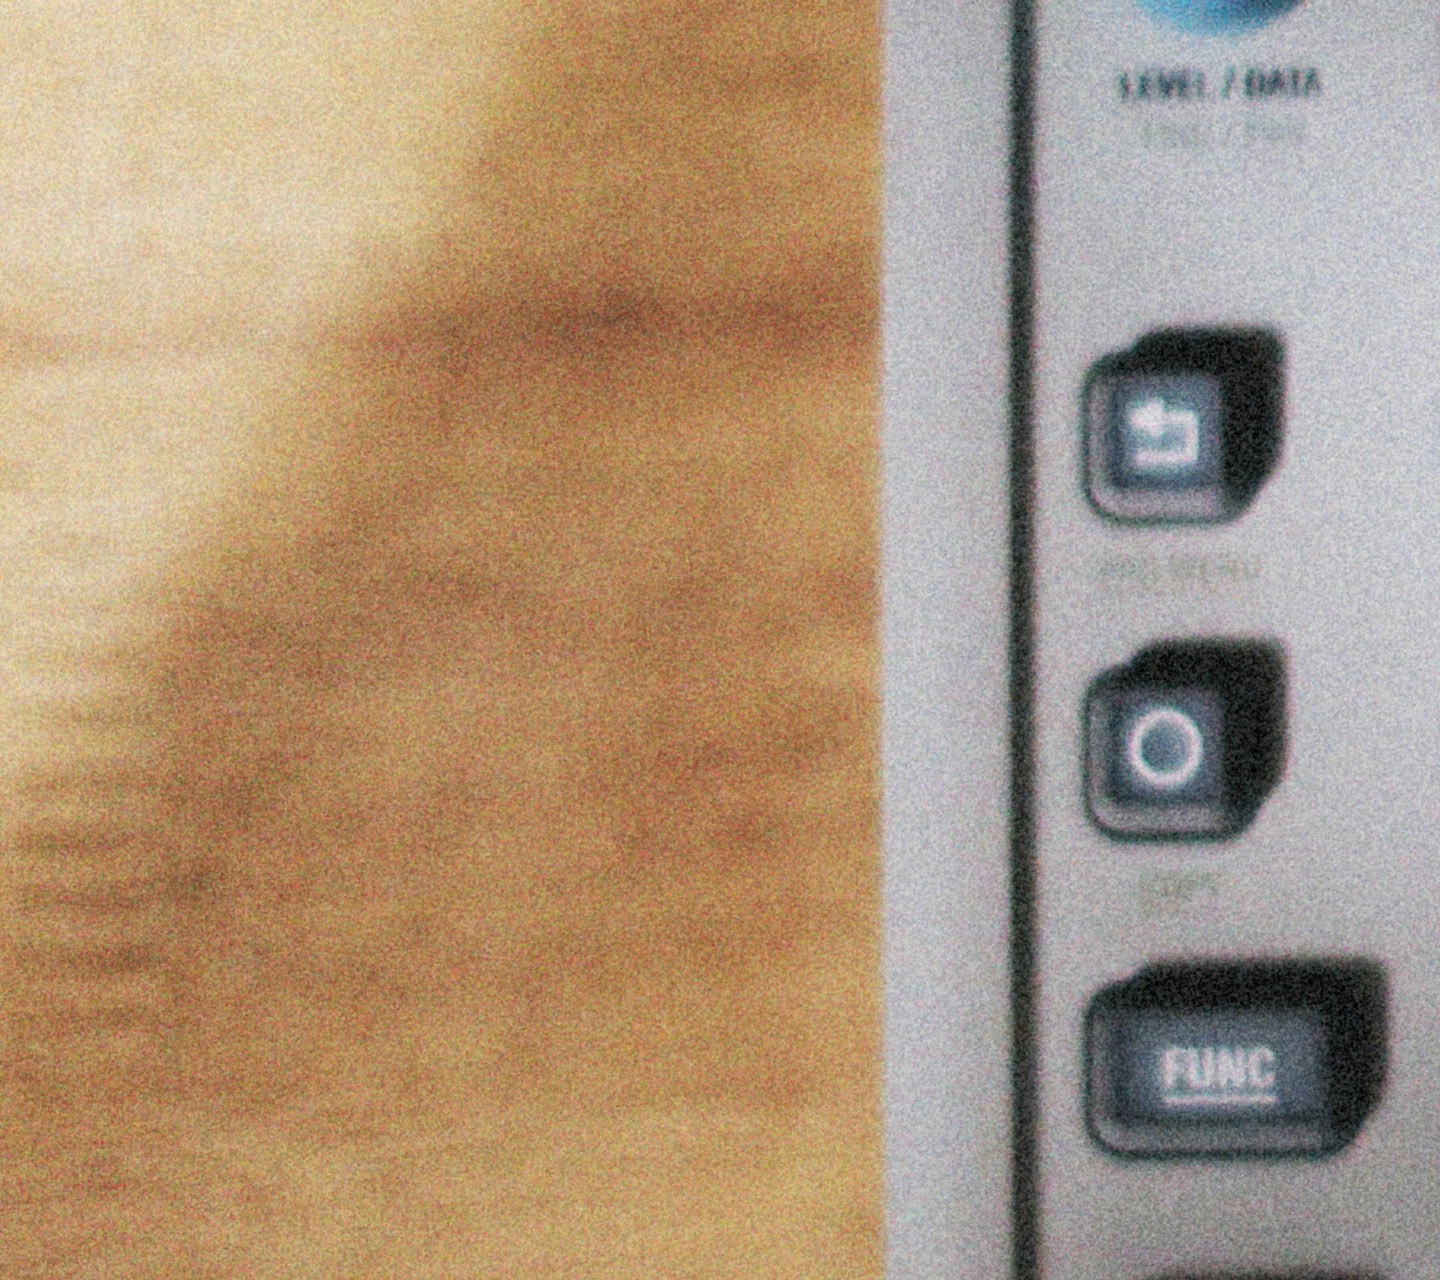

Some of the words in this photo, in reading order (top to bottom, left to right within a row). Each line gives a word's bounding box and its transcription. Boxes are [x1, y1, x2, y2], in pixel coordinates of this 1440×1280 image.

[1117, 71, 1206, 101] LEVEL
[1243, 68, 1320, 99] DATA
[1160, 1046, 1276, 1093] FUNC
